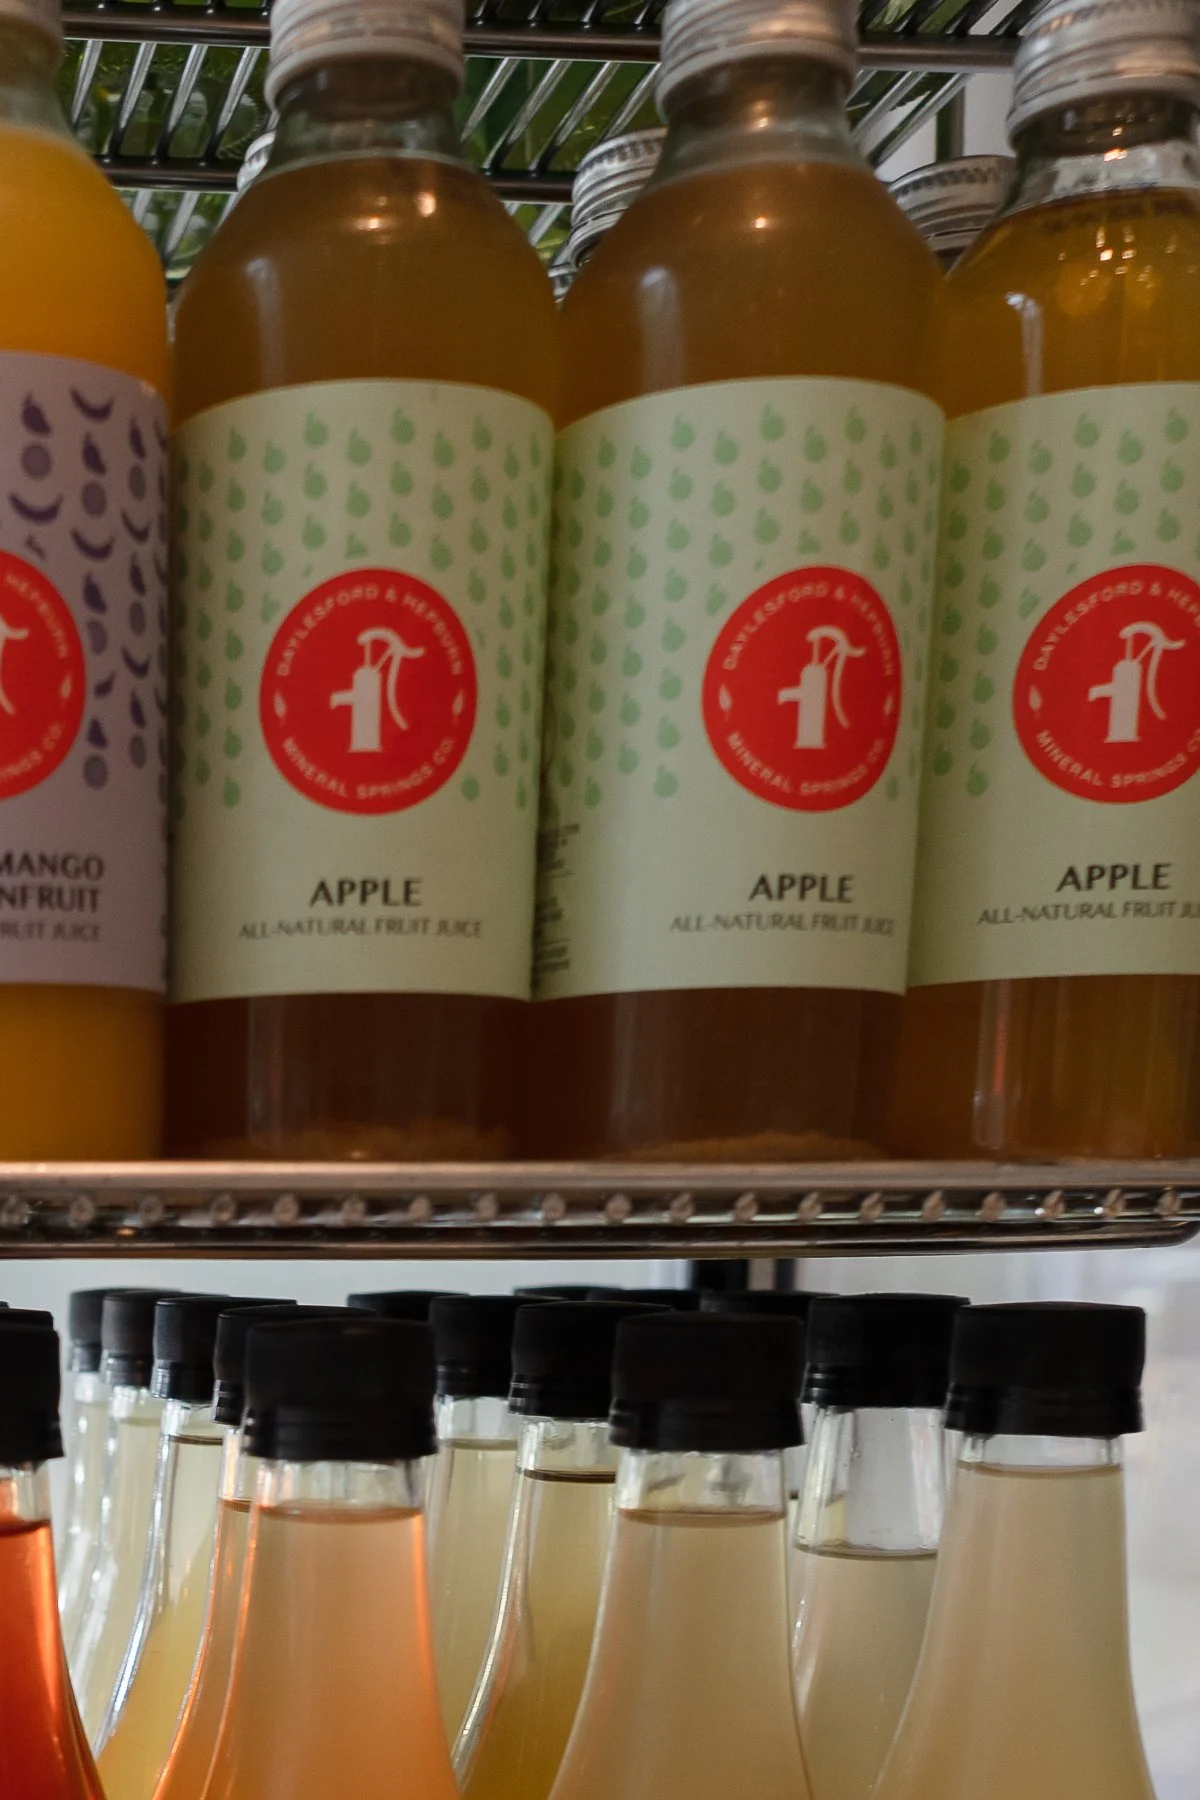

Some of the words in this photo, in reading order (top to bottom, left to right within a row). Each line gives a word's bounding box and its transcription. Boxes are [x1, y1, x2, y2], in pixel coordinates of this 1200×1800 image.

[310, 877, 422, 907] APPLE
[749, 873, 854, 903] APPLE
[1057, 863, 1172, 892] APPLE
